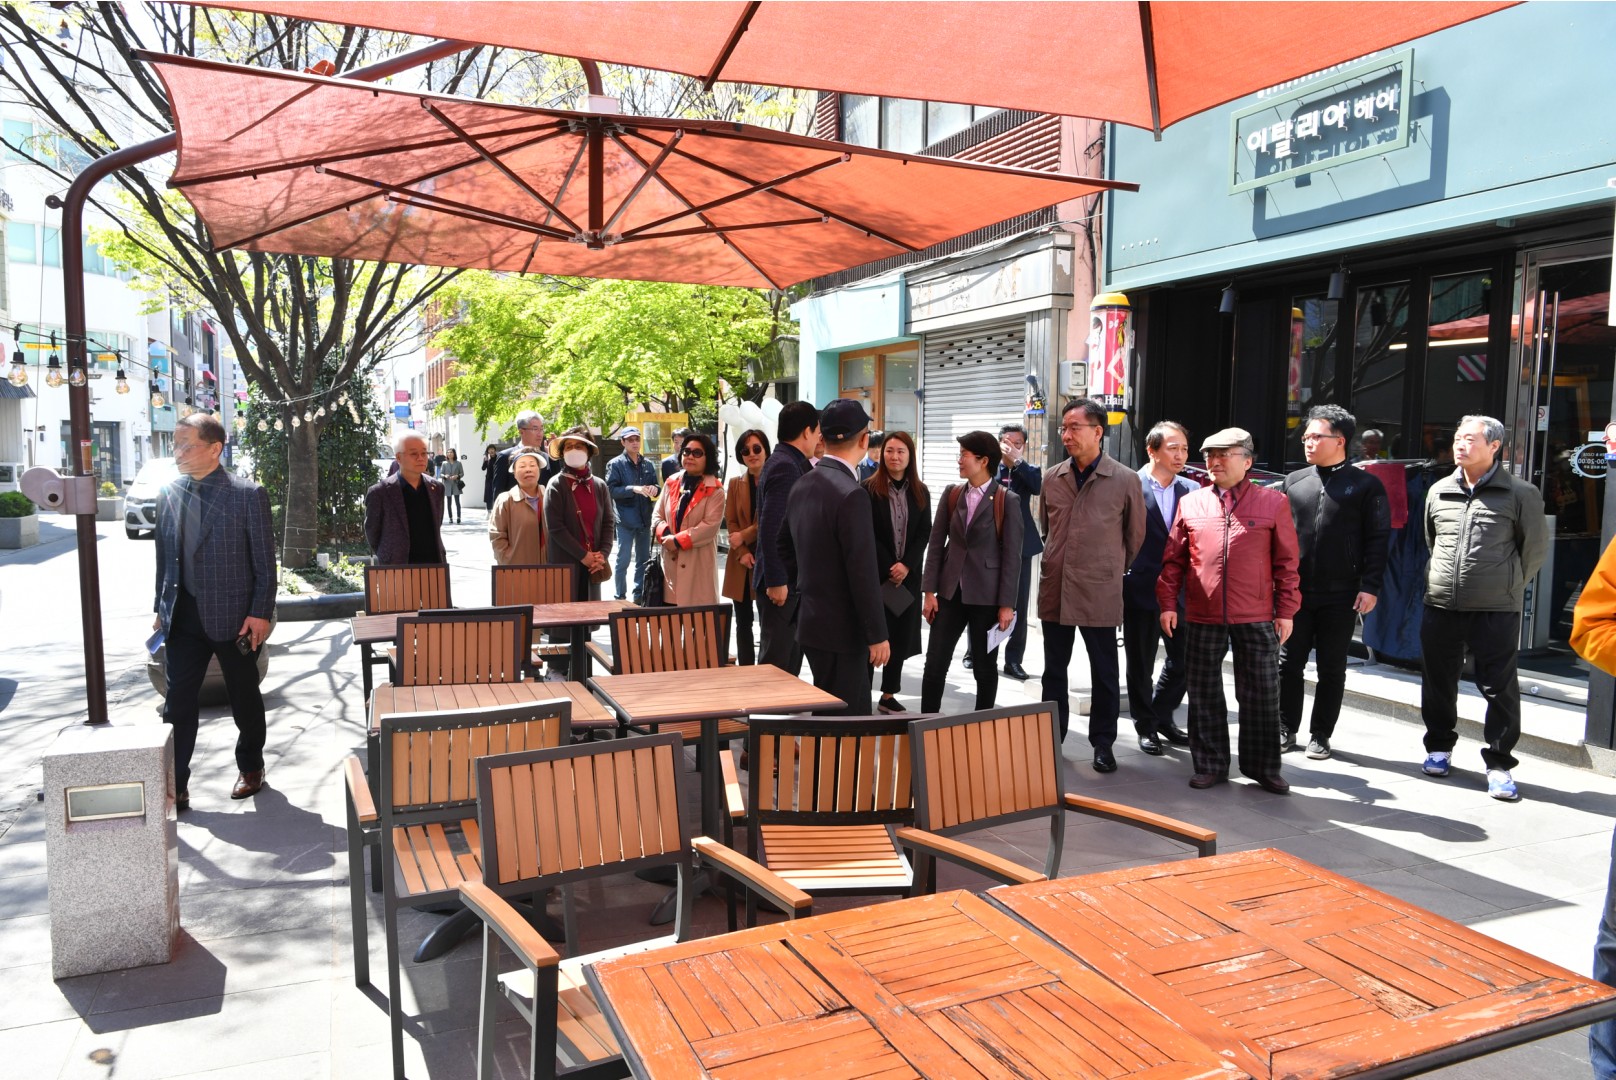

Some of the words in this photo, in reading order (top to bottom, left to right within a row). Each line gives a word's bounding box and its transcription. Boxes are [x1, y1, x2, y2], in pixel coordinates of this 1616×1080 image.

[1247, 101, 1347, 158] 이탈리아
[1354, 88, 1394, 119] 헤어
[1105, 394, 1124, 406] Hair
